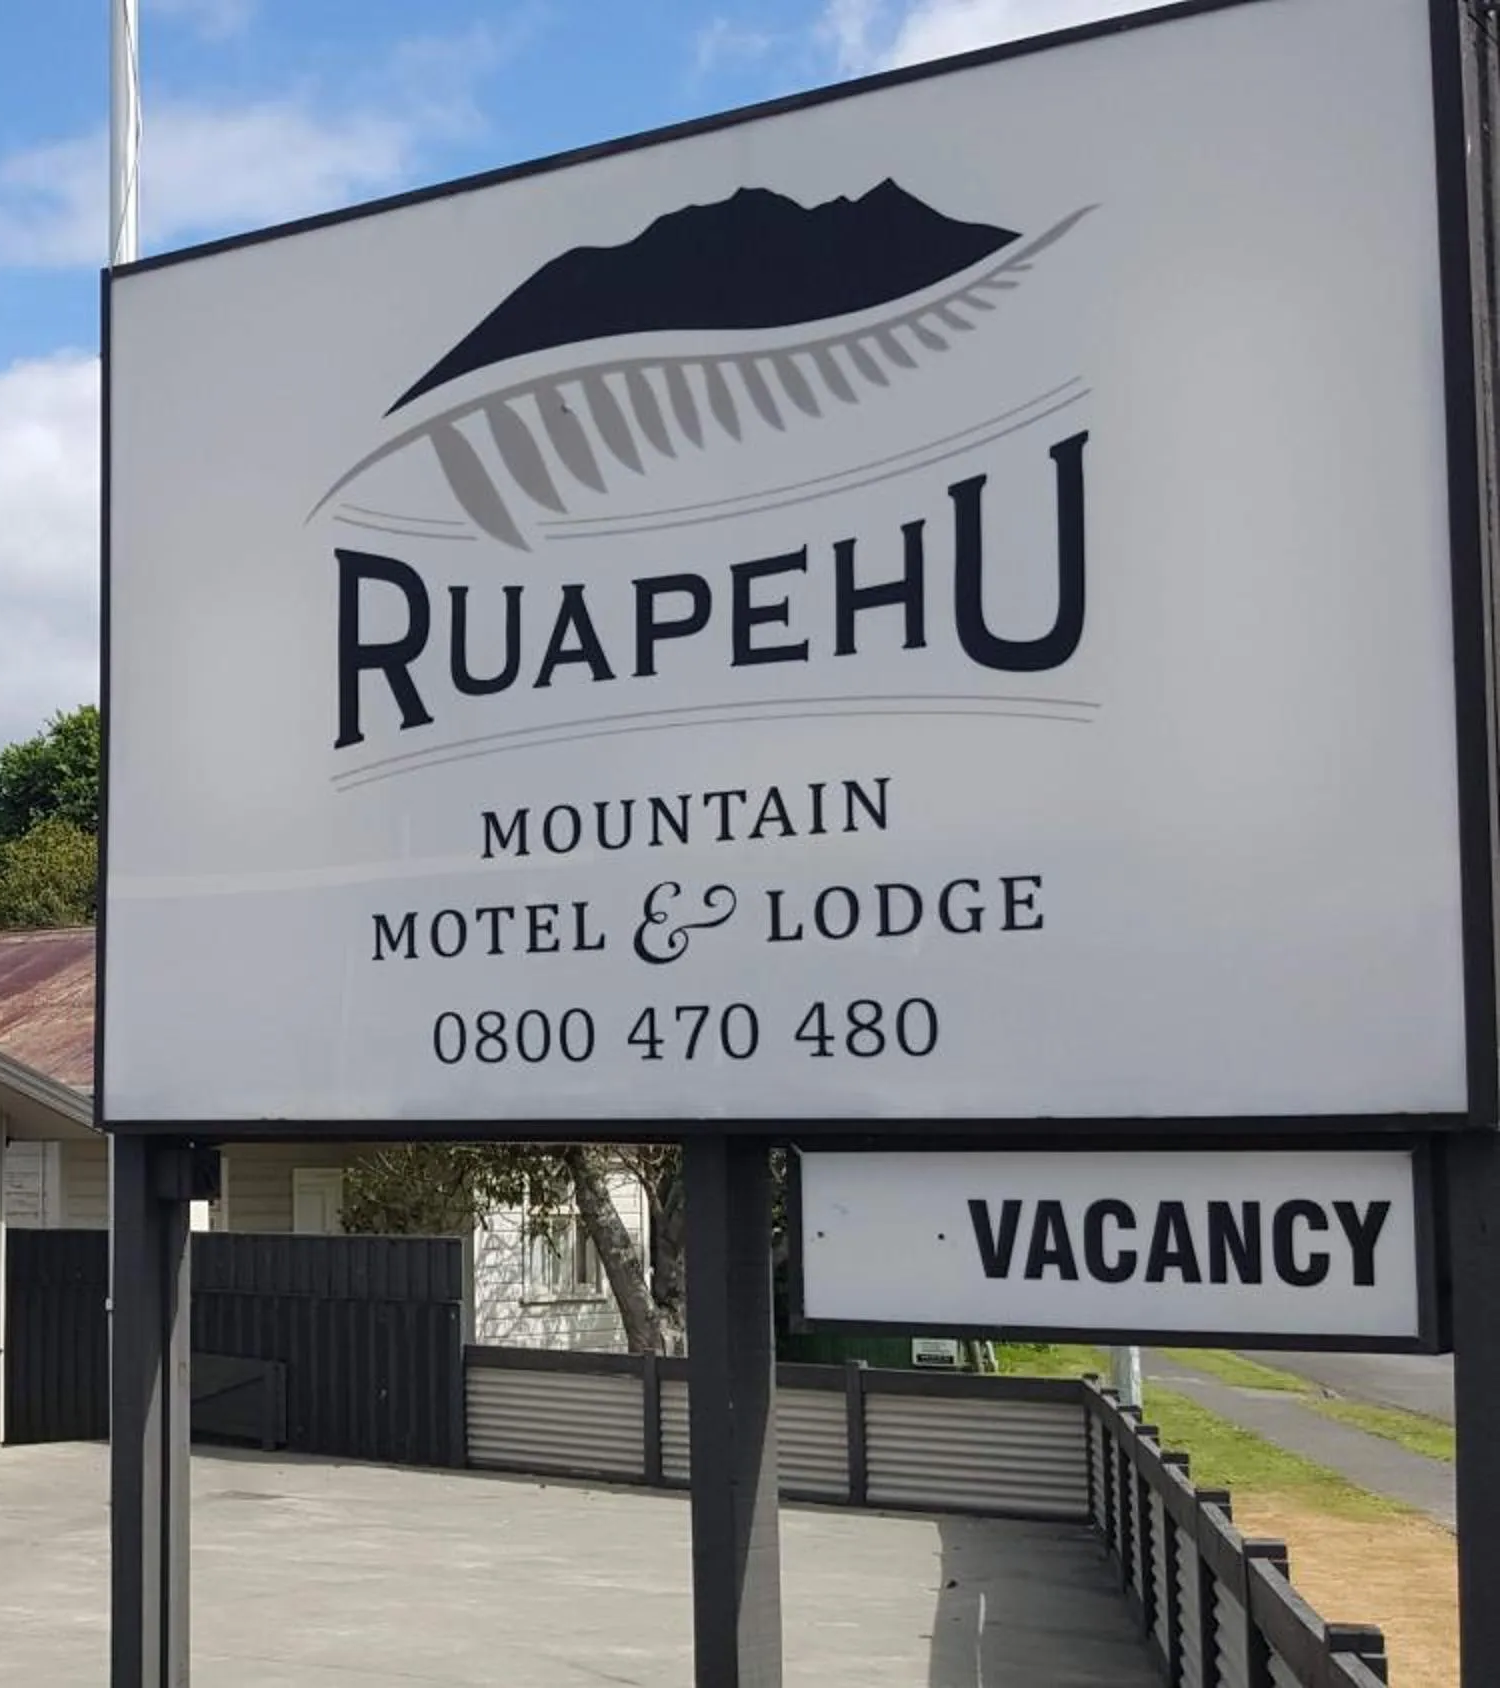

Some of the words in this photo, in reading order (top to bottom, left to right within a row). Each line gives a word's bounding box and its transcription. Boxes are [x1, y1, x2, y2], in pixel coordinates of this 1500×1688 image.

[332, 429, 1090, 750] RUAPEHU
[480, 777, 892, 859] MOUNTAIN
[370, 901, 607, 962] MOTEL
[632, 881, 738, 965] &
[764, 875, 1045, 943] LODGE
[432, 1007, 596, 1065] 0800
[626, 1002, 760, 1062] 470
[793, 997, 940, 1059] 480
[966, 1197, 1393, 1288] VACANCY
